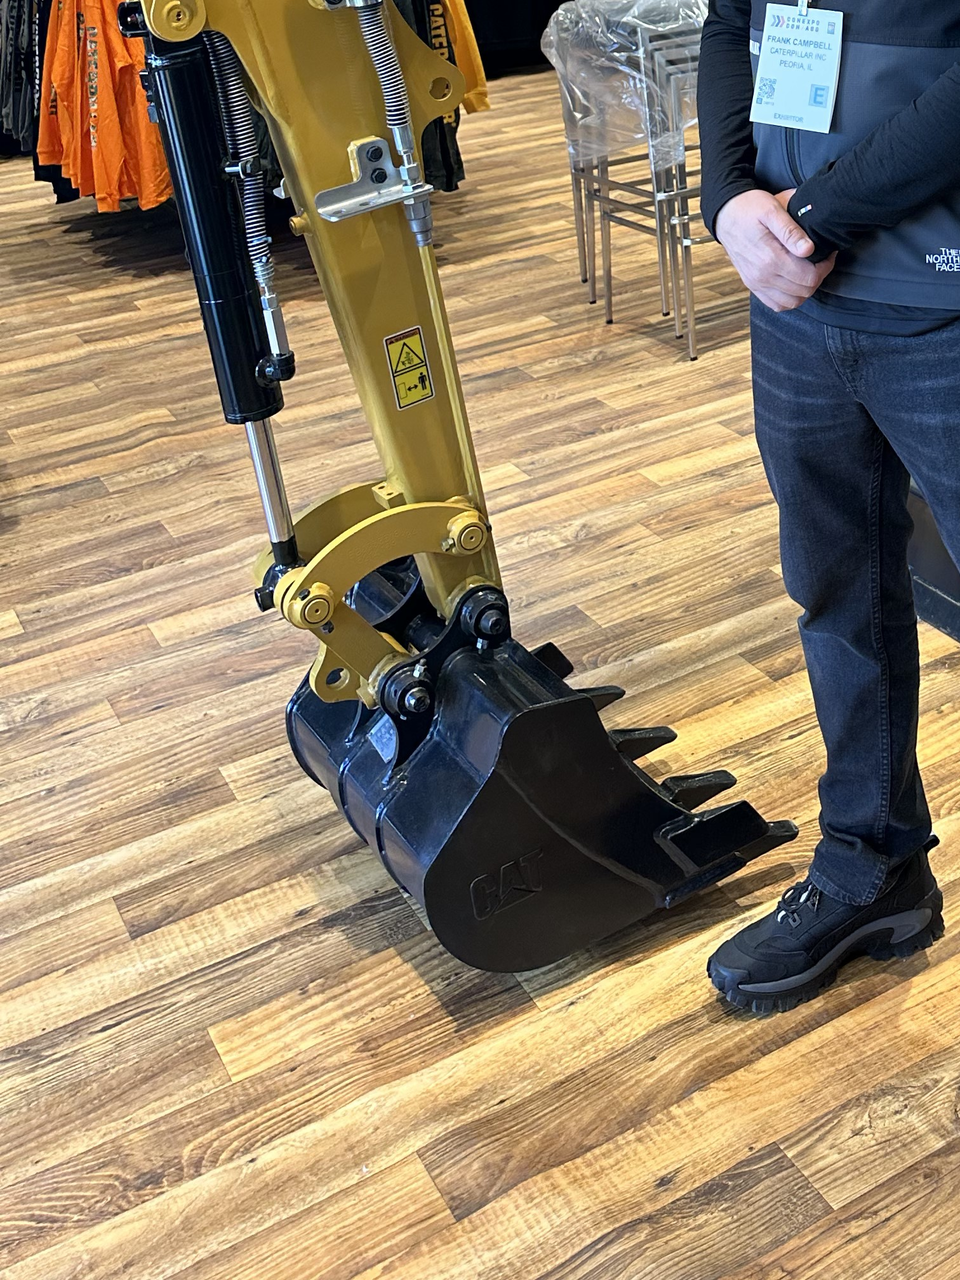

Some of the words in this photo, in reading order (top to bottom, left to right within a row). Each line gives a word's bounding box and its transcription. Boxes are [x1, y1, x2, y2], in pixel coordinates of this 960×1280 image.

[767, 35, 791, 46] FRANK
[792, 38, 833, 51] CAMPBELL
[770, 46, 813, 59] CATERPILLAR
[813, 87, 825, 105] E
[940, 247, 959, 256] THE
[926, 254, 960, 264] NORTH
[936, 263, 960, 272] FACE
[470, 848, 544, 921] CAT
